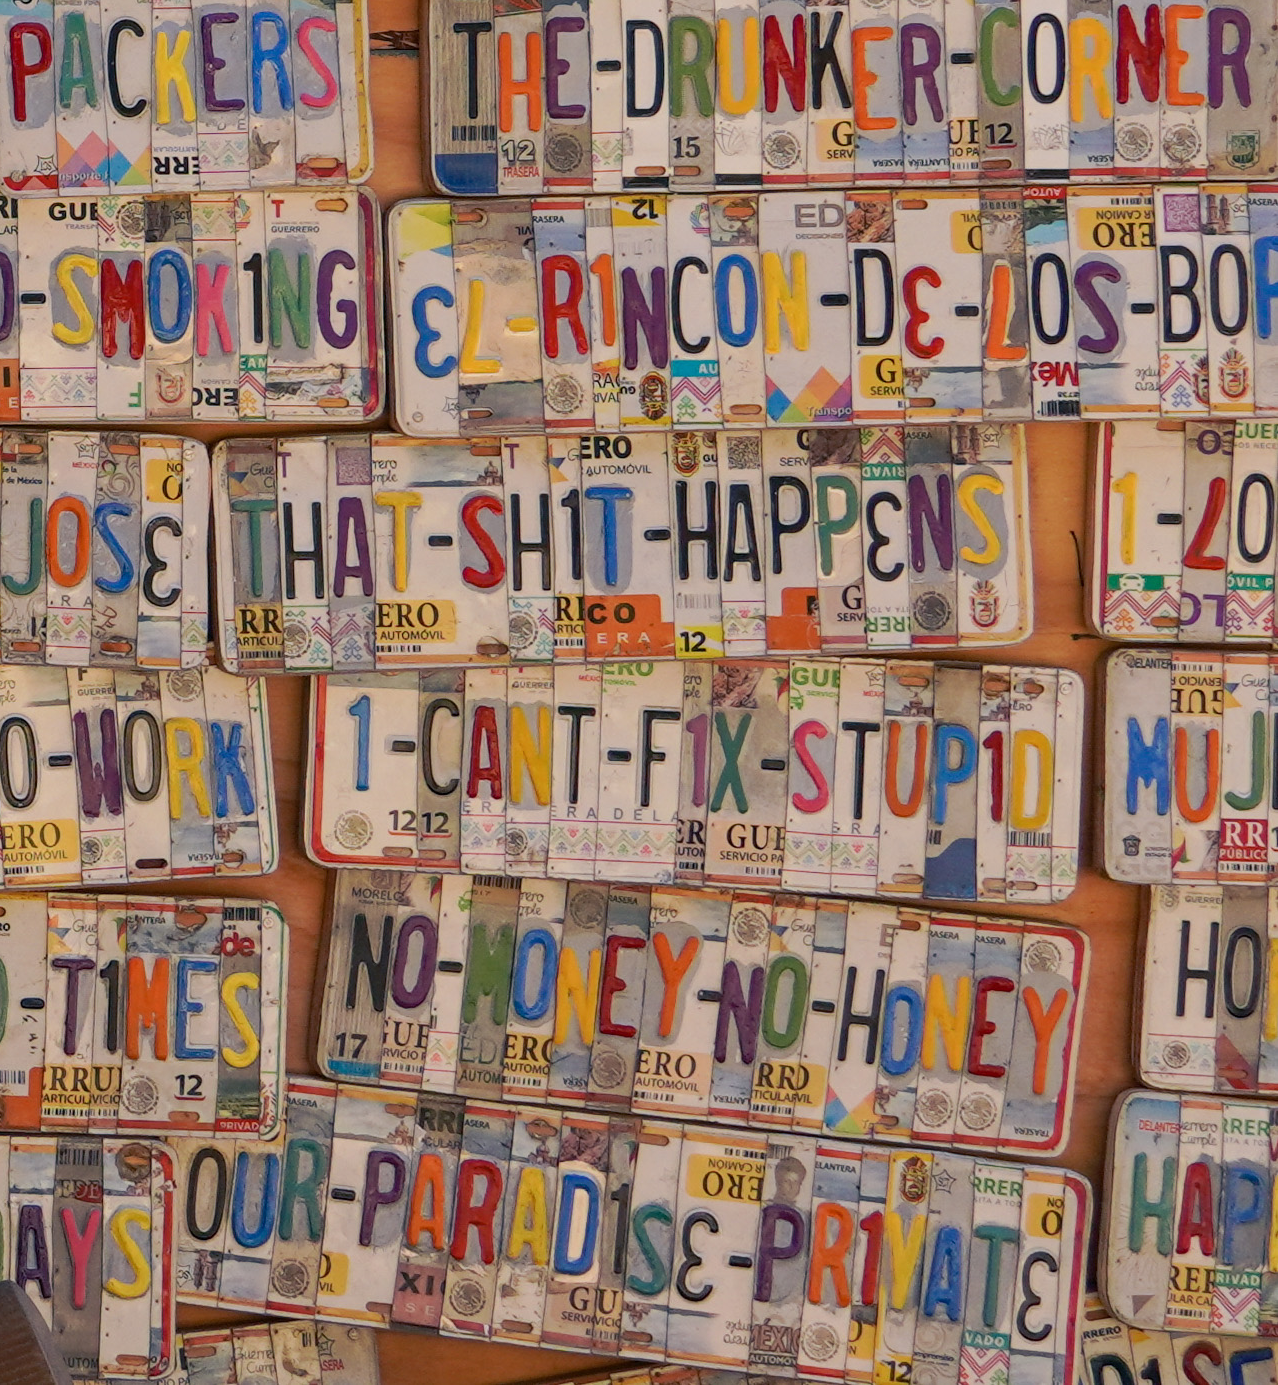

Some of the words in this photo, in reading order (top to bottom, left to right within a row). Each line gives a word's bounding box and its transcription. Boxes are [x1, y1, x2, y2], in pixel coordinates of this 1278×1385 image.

[984, 122, 1014, 145] 12
[673, 136, 701, 159] 15
[631, 198, 659, 220] 12
[680, 631, 707, 653] 12
[1126, 710, 1278, 822] MUJ
[389, 810, 417, 832] 12
[1177, 920, 1278, 1040] HO
[335, 1031, 368, 1060] 17
[175, 1074, 203, 1097] 12
[1129, 1152, 1278, 1270] HAP
